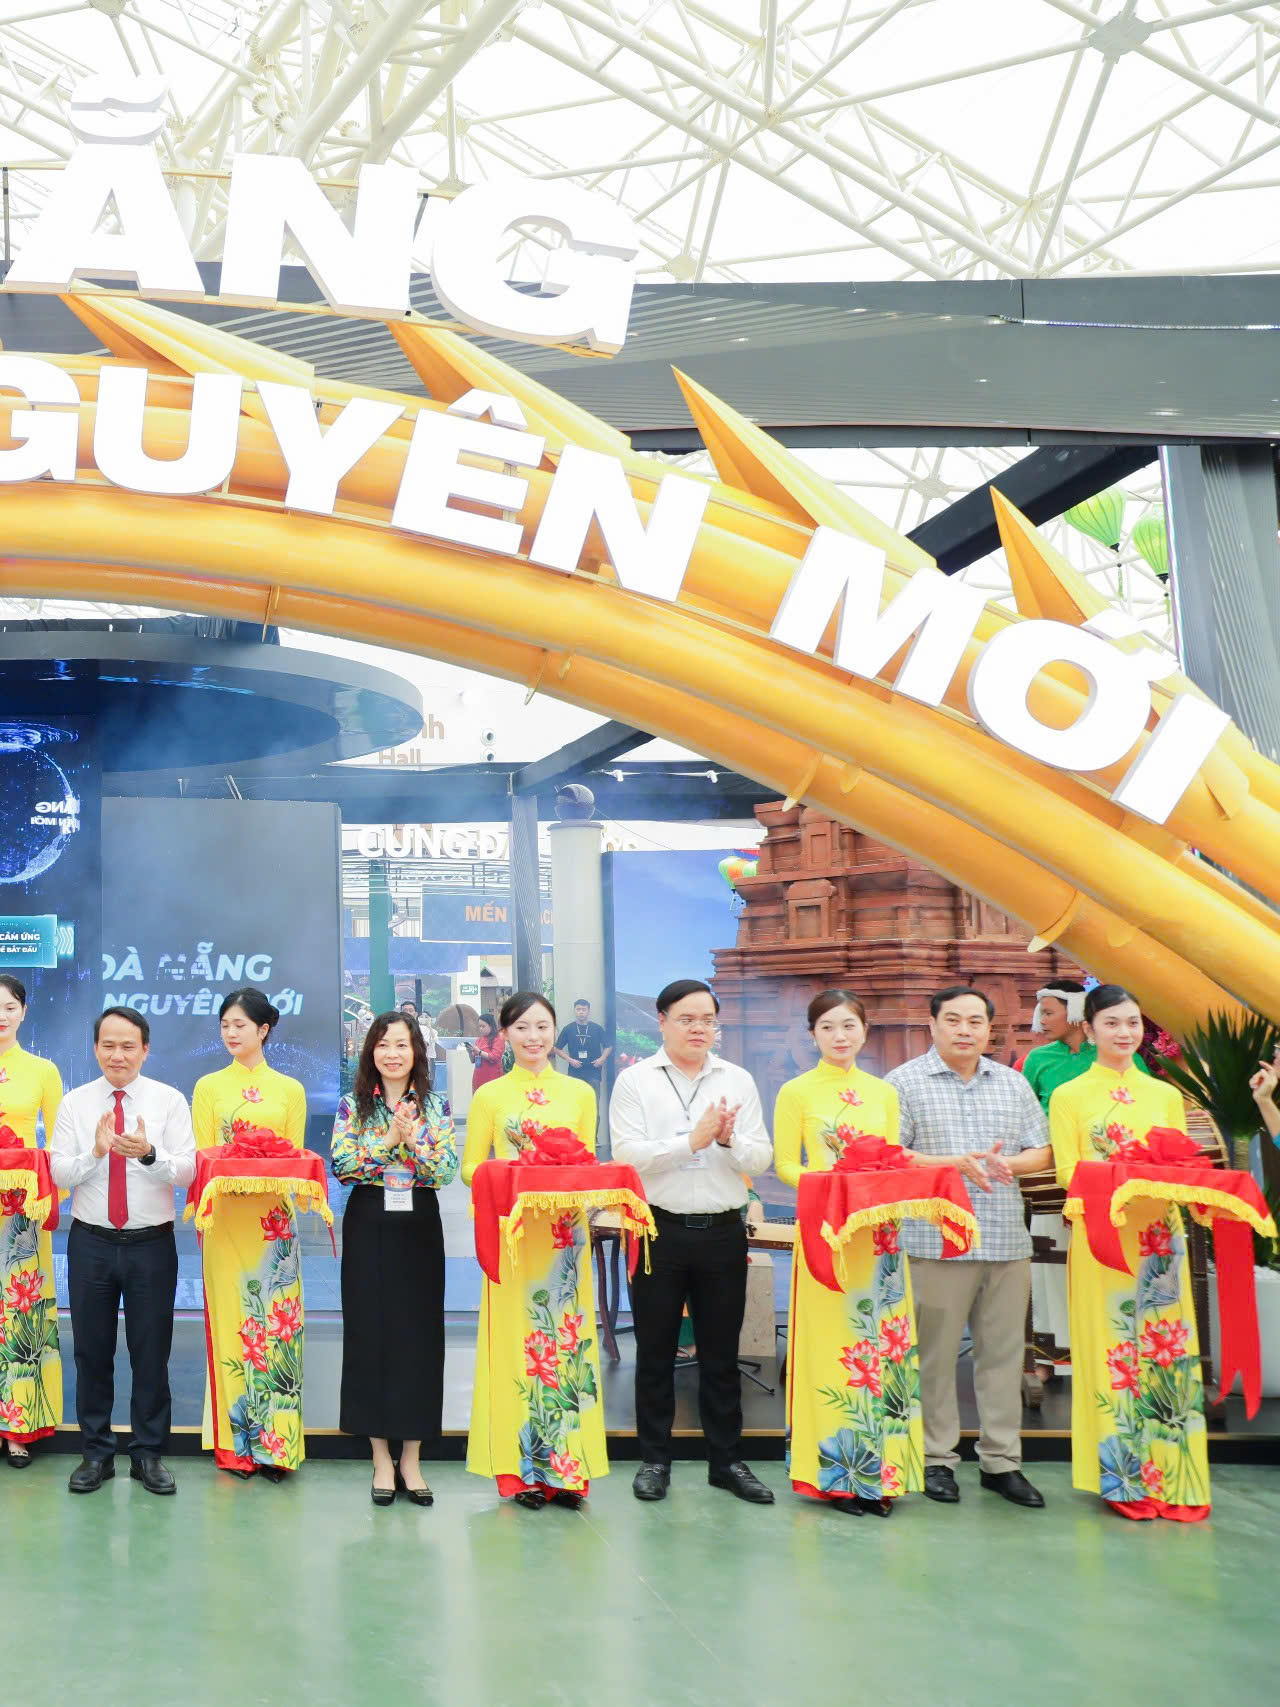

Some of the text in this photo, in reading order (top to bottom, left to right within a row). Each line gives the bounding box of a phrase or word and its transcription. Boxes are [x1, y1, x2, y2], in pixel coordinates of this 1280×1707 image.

[769, 525, 1232, 826] MỚI
[378, 748, 422, 765] Hall
[357, 825, 470, 859] CUNG
[464, 900, 508, 923] MẾN
